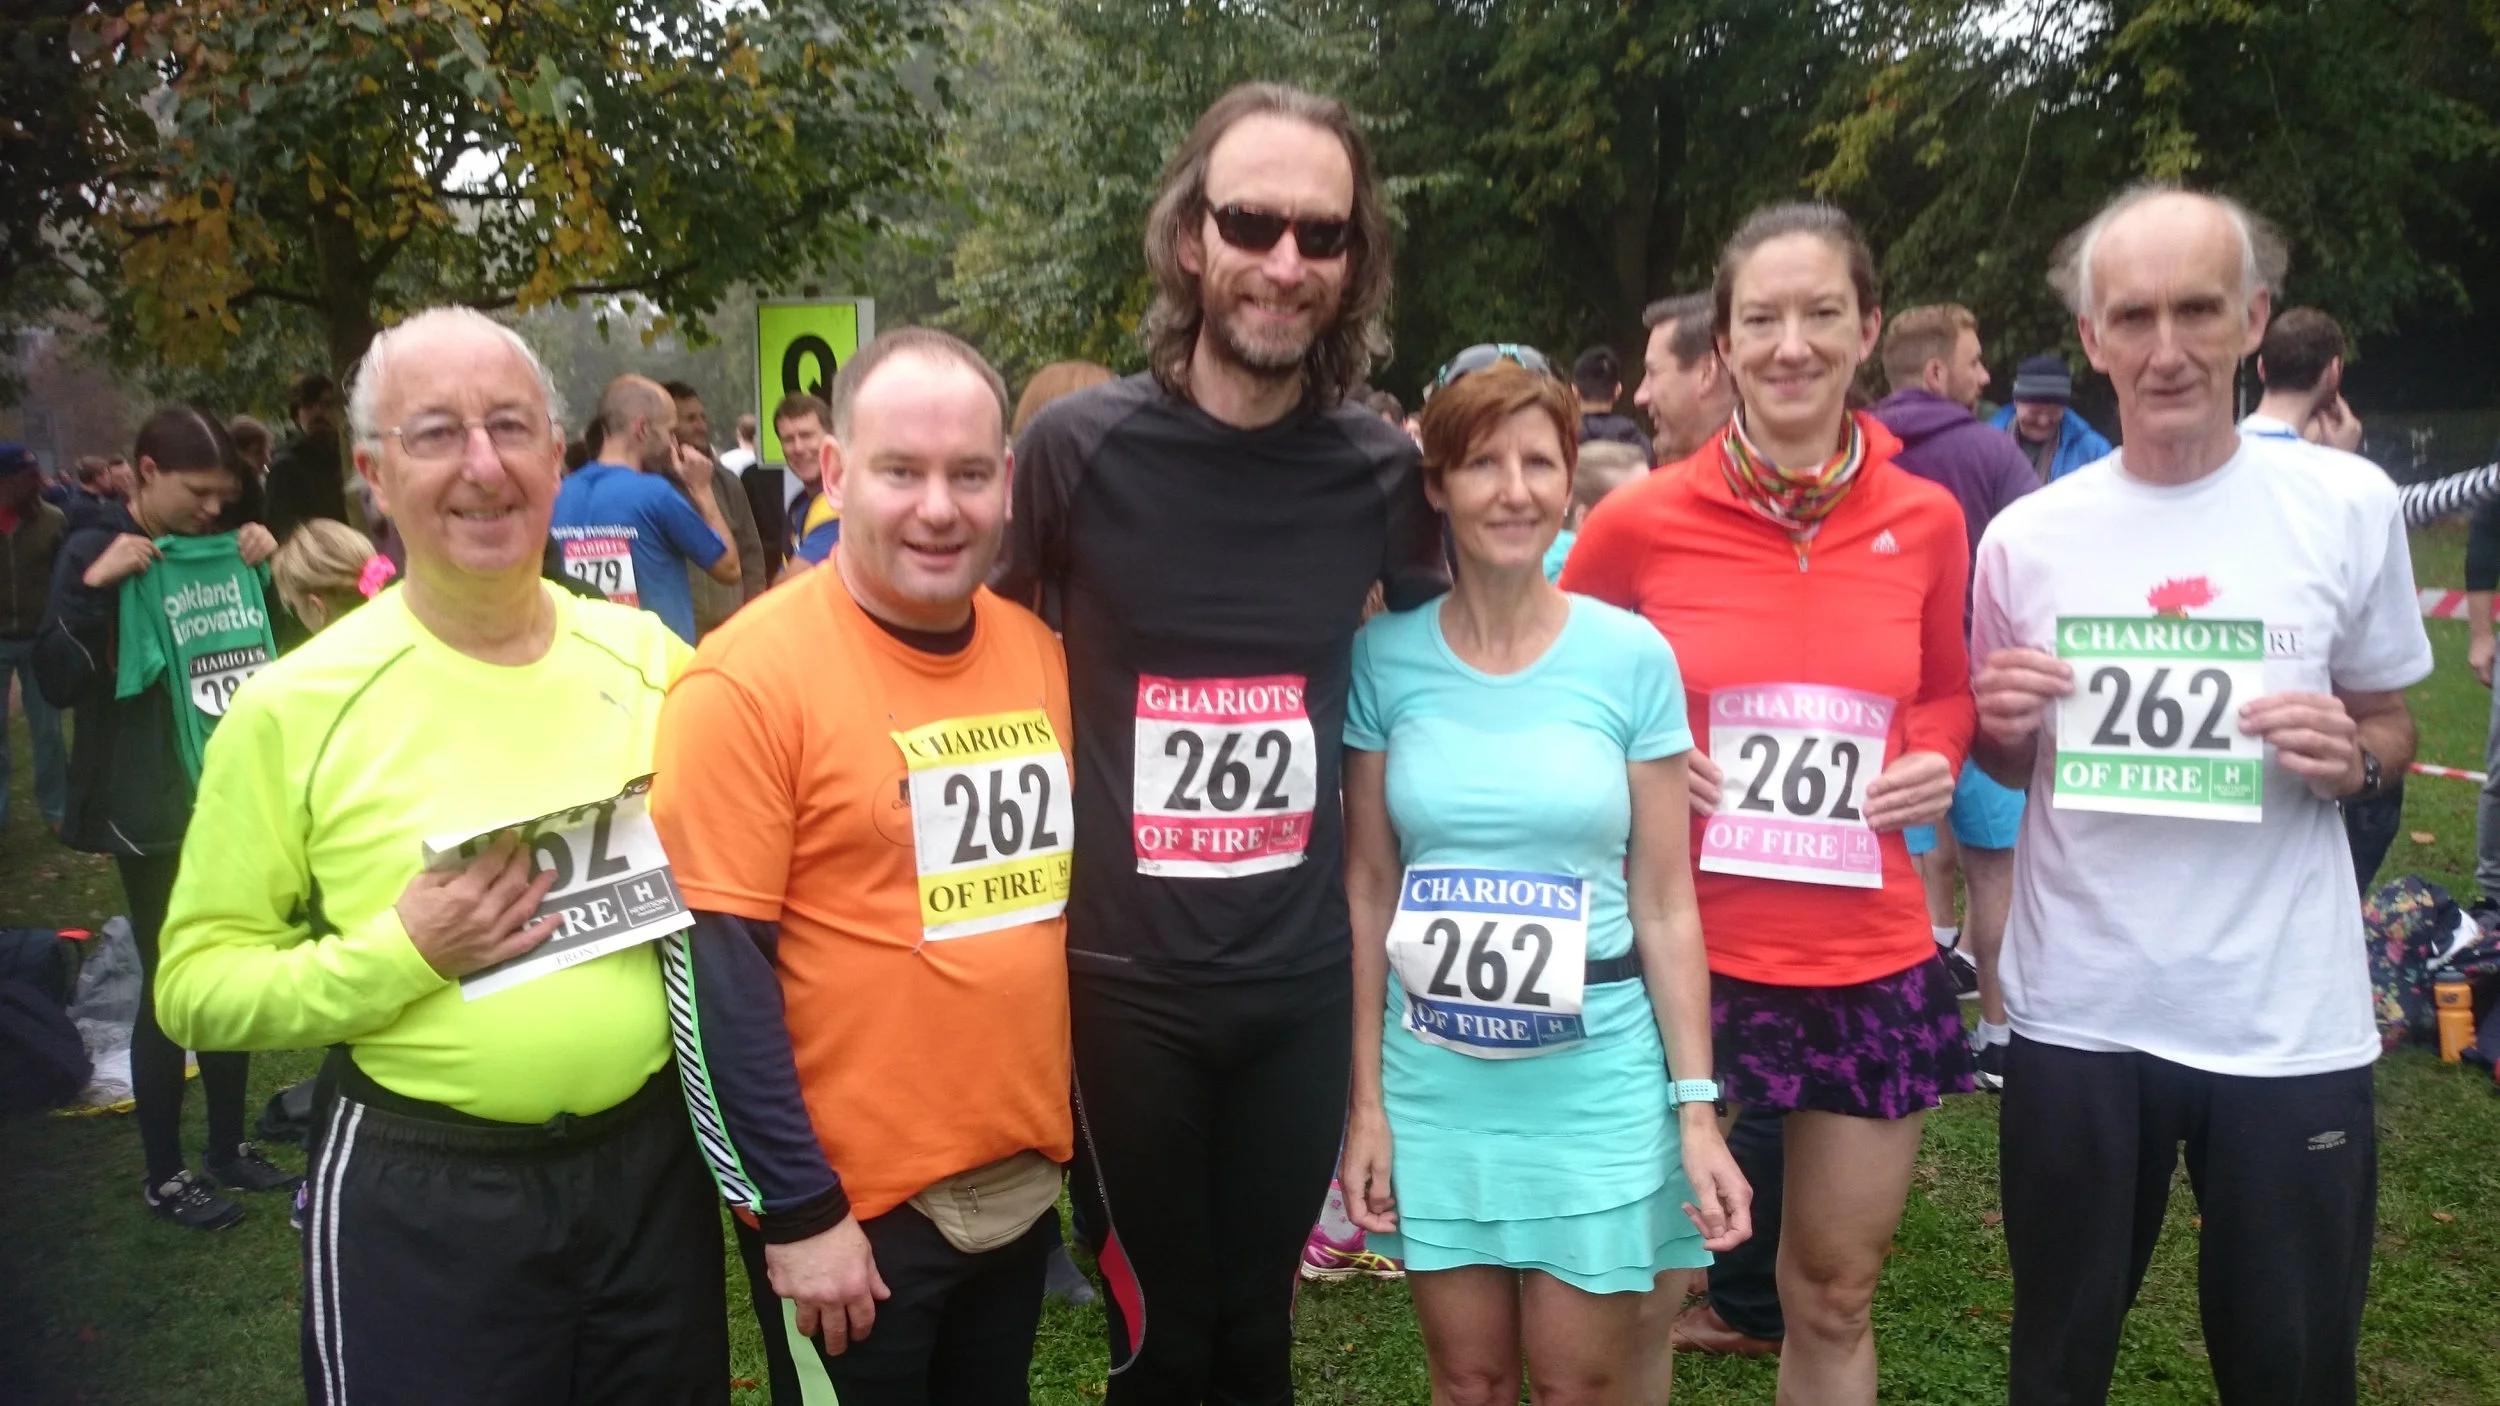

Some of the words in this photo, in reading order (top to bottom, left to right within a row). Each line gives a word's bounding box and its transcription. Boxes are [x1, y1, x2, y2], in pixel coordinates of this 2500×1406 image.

[782, 333, 838, 404] Q
[2064, 622, 2257, 653] CHARIOTS
[1145, 683, 1301, 715] CHARIOTS
[1718, 692, 1886, 728] CHARIOTS
[2089, 666, 2232, 751] 262
[909, 718, 1051, 757] CHARIOTS
[1164, 729, 1292, 812] 262
[1738, 734, 1860, 821] 262
[2062, 761, 2111, 788] OF
[2118, 763, 2203, 794] FIRE
[944, 763, 1058, 865] 262
[1138, 824, 1183, 850] OF
[1190, 826, 1264, 853] FIRE
[1708, 824, 1754, 850] OF
[1760, 828, 1839, 861] FIRE
[633, 881, 655, 902] H
[929, 882, 976, 913] OF
[984, 868, 1047, 904] FIRE
[1411, 877, 1576, 911] CHARIOTS
[556, 944, 600, 966] FRONT
[1422, 917, 1553, 1008] 262
[1416, 1002, 1448, 1030] OF
[1455, 1012, 1532, 1041] FIRE
